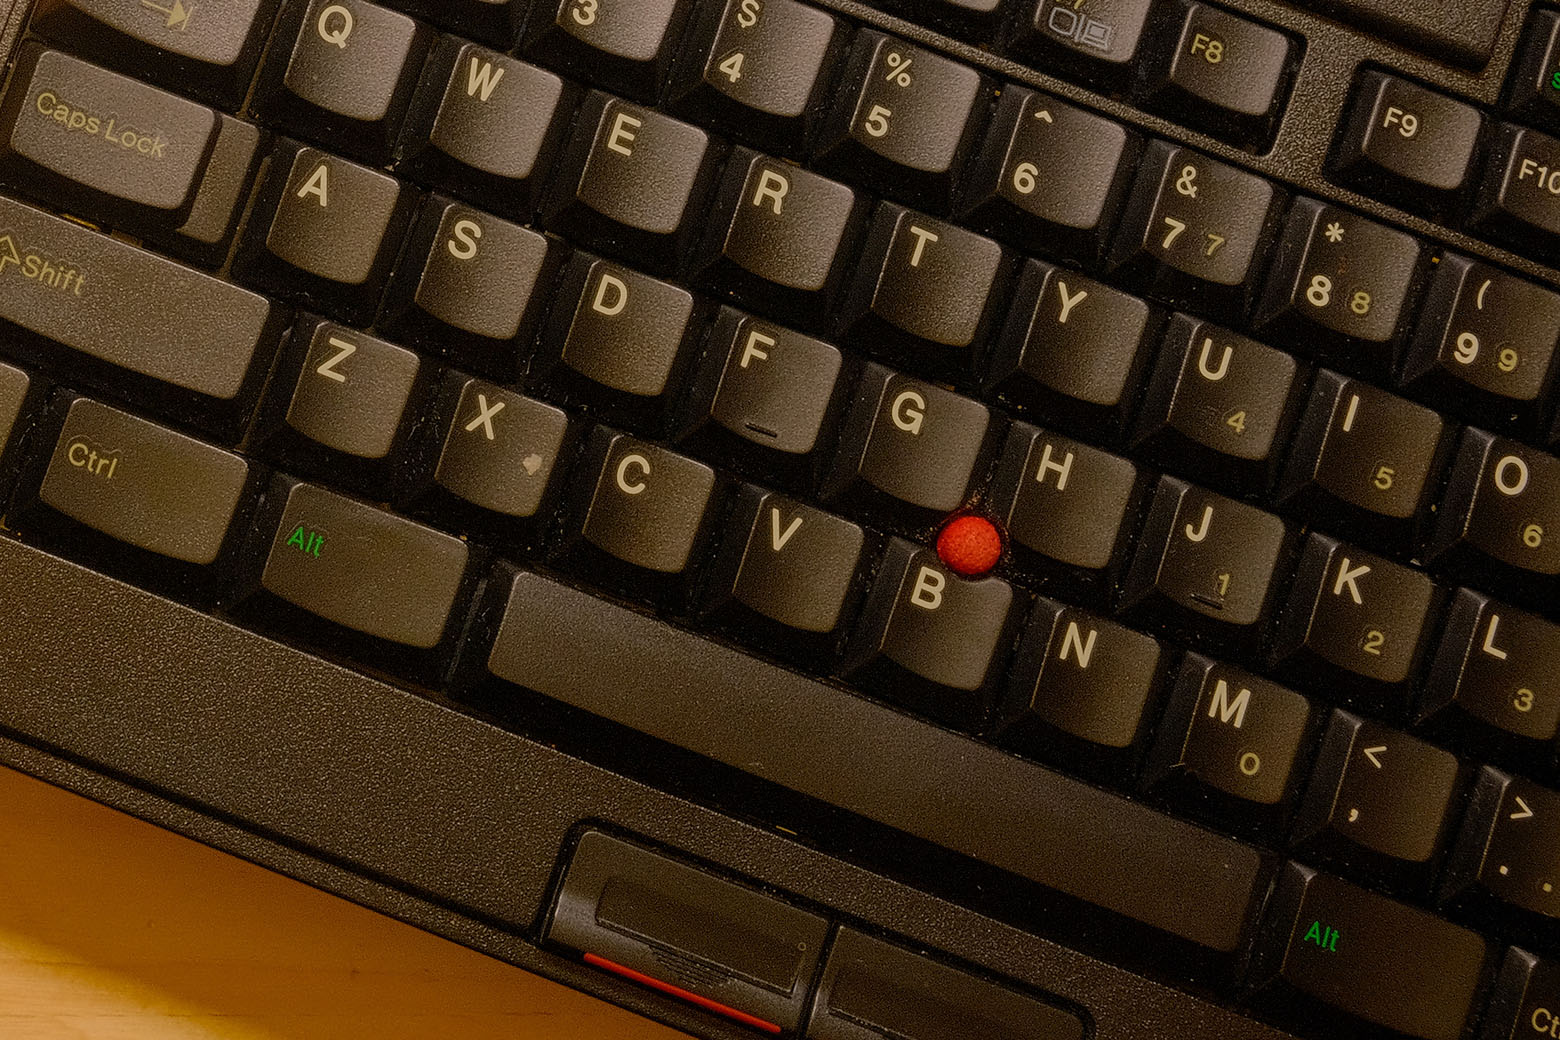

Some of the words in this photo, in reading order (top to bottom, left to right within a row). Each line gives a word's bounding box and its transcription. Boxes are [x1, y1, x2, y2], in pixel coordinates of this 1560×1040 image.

[319, 6, 352, 48] Q
[1192, 34, 1223, 63] F8
[468, 58, 504, 101] W
[720, 53, 744, 82] 4
[887, 53, 911, 87] %
[38, 93, 100, 133] Caps
[104, 118, 166, 158] Lock
[608, 113, 641, 156] E
[866, 105, 891, 136] 5
[1384, 108, 1417, 137] F9
[298, 165, 327, 206] A
[754, 170, 788, 214] R
[1014, 163, 1038, 193] 6
[1176, 166, 1199, 198] &
[449, 221, 481, 259] S
[911, 226, 938, 266] T
[1163, 218, 1185, 248] 7
[1205, 234, 1226, 257] 7
[22, 256, 84, 295] Shift
[1307, 275, 1331, 306] 8
[593, 274, 627, 315] D
[1059, 282, 1087, 322] Y
[1352, 292, 1370, 313] 8
[1478, 280, 1490, 309] (
[317, 338, 356, 382] Z
[741, 331, 775, 367] F
[1199, 339, 1232, 380] U
[1454, 333, 1478, 364] 9
[1499, 349, 1517, 371] 9
[466, 395, 505, 440] X
[892, 392, 924, 434] G
[1228, 412, 1245, 432] 4
[69, 443, 117, 478] Ctrl
[617, 455, 650, 494] C
[1037, 445, 1073, 490] H
[1375, 467, 1394, 489] 5
[1495, 456, 1528, 495] O
[773, 508, 802, 551] V
[1186, 506, 1213, 541] J
[1524, 525, 1543, 547] 6
[288, 527, 323, 556] Alt
[911, 567, 945, 609] B
[1219, 574, 1229, 595] 1
[1334, 558, 1370, 604] K
[1060, 622, 1097, 668] N
[1364, 631, 1384, 654] 2
[1483, 615, 1506, 659] L
[1209, 680, 1250, 728] M
[1514, 689, 1533, 711] 3
[1304, 922, 1339, 951] Alt
[1531, 1007, 1560, 1040] Ct
